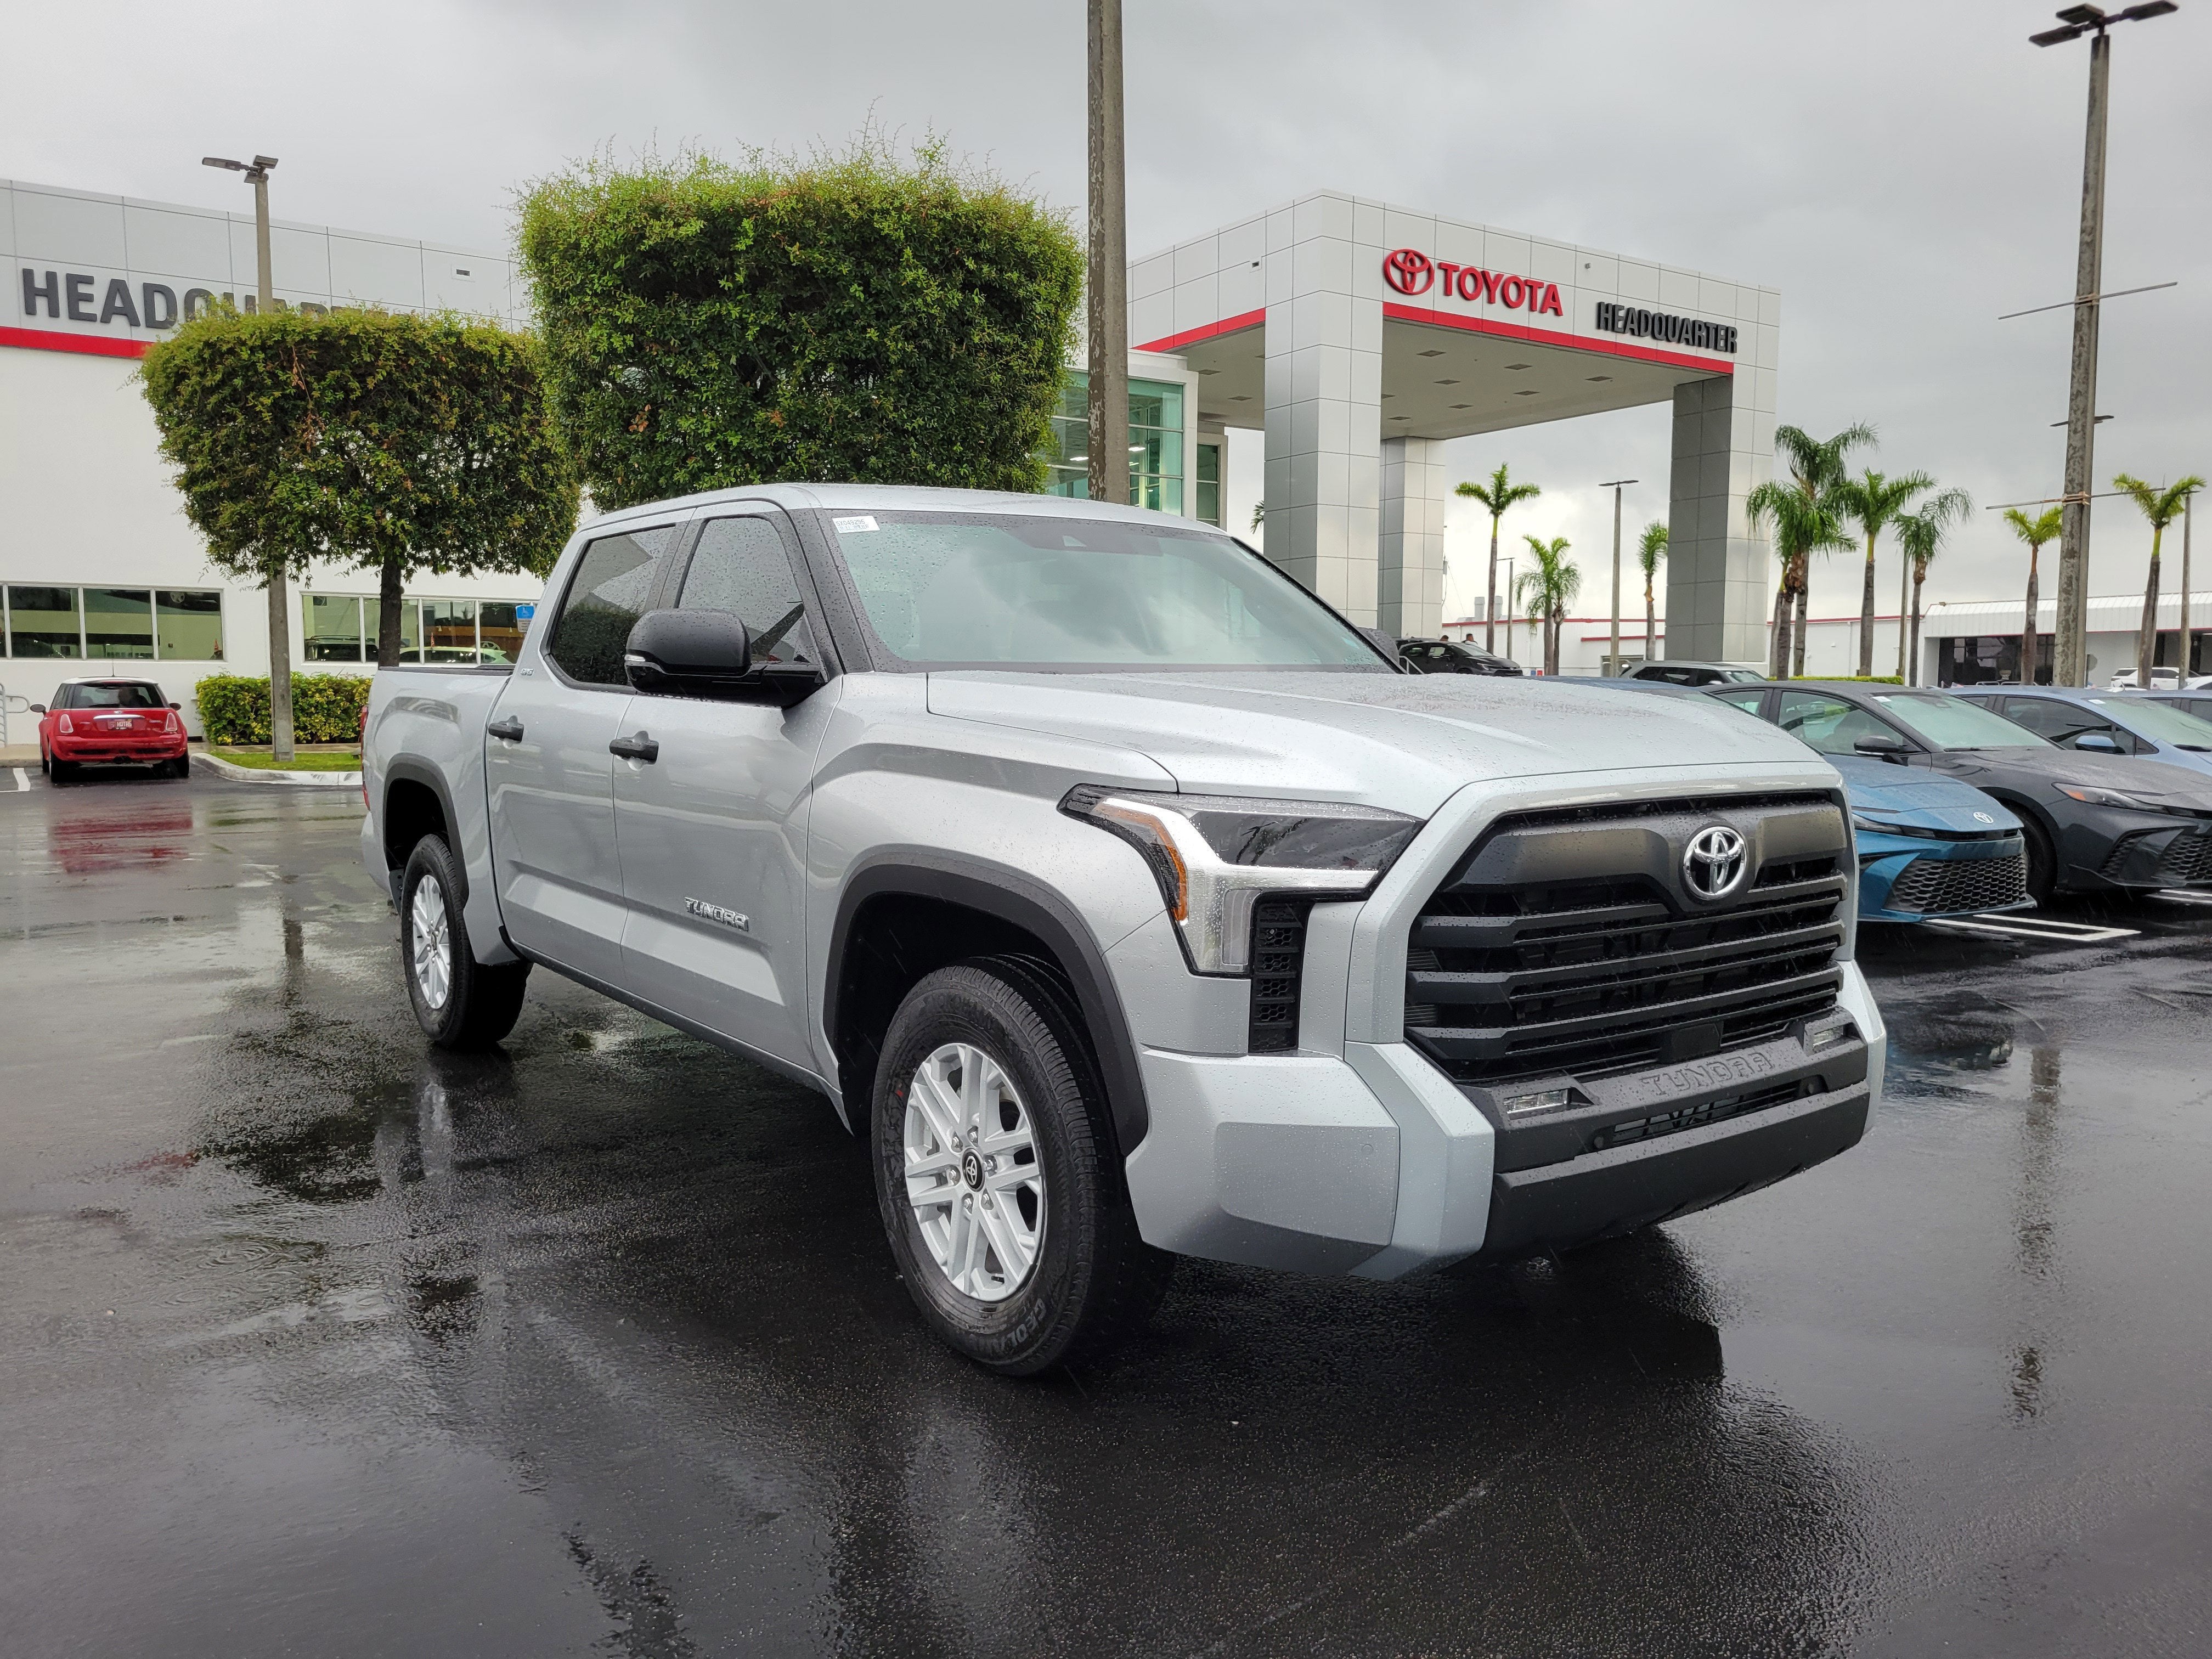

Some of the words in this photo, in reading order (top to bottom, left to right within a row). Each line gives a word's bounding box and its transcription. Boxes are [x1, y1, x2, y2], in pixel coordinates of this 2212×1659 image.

[1438, 262, 1564, 317] TOYOTA
[1597, 301, 1737, 354] HEADQUARTER
[685, 896, 749, 932] TUNDRA
[1639, 1052, 1775, 1096] TUNDRA
